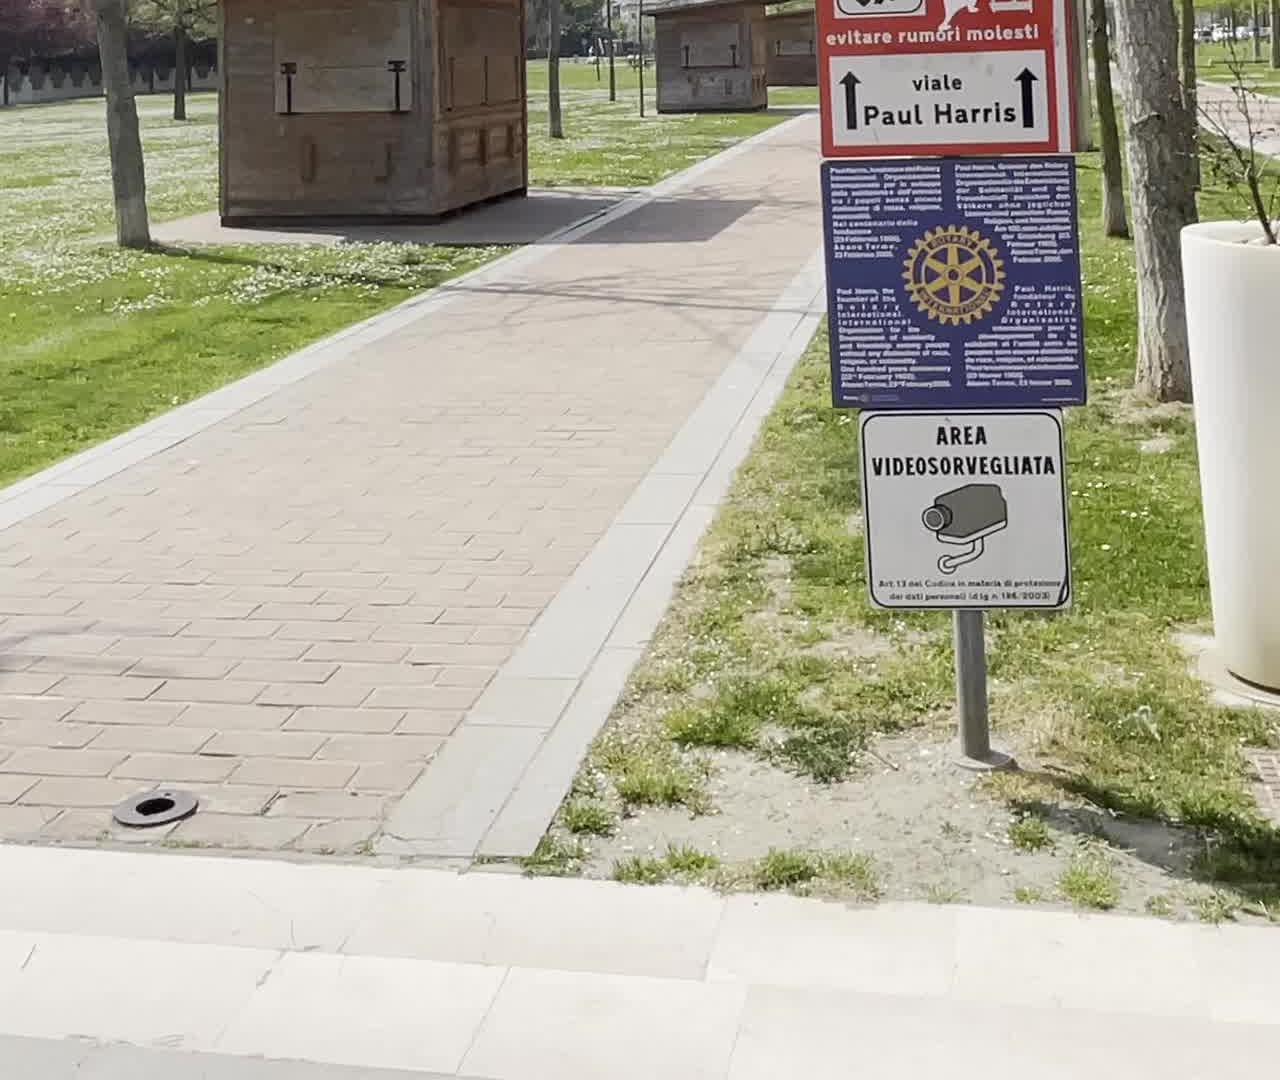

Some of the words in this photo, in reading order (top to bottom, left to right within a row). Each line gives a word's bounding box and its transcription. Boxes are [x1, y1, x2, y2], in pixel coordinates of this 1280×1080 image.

[826, 30, 892, 46] evitare
[898, 27, 961, 44] rumori
[966, 23, 1039, 42] molesti
[912, 74, 963, 92] viale
[864, 104, 923, 126] Paul
[934, 101, 1017, 125] Harris
[936, 426, 987, 445] AREA
[872, 456, 1056, 476] VIDEOSORVEGLIATA
